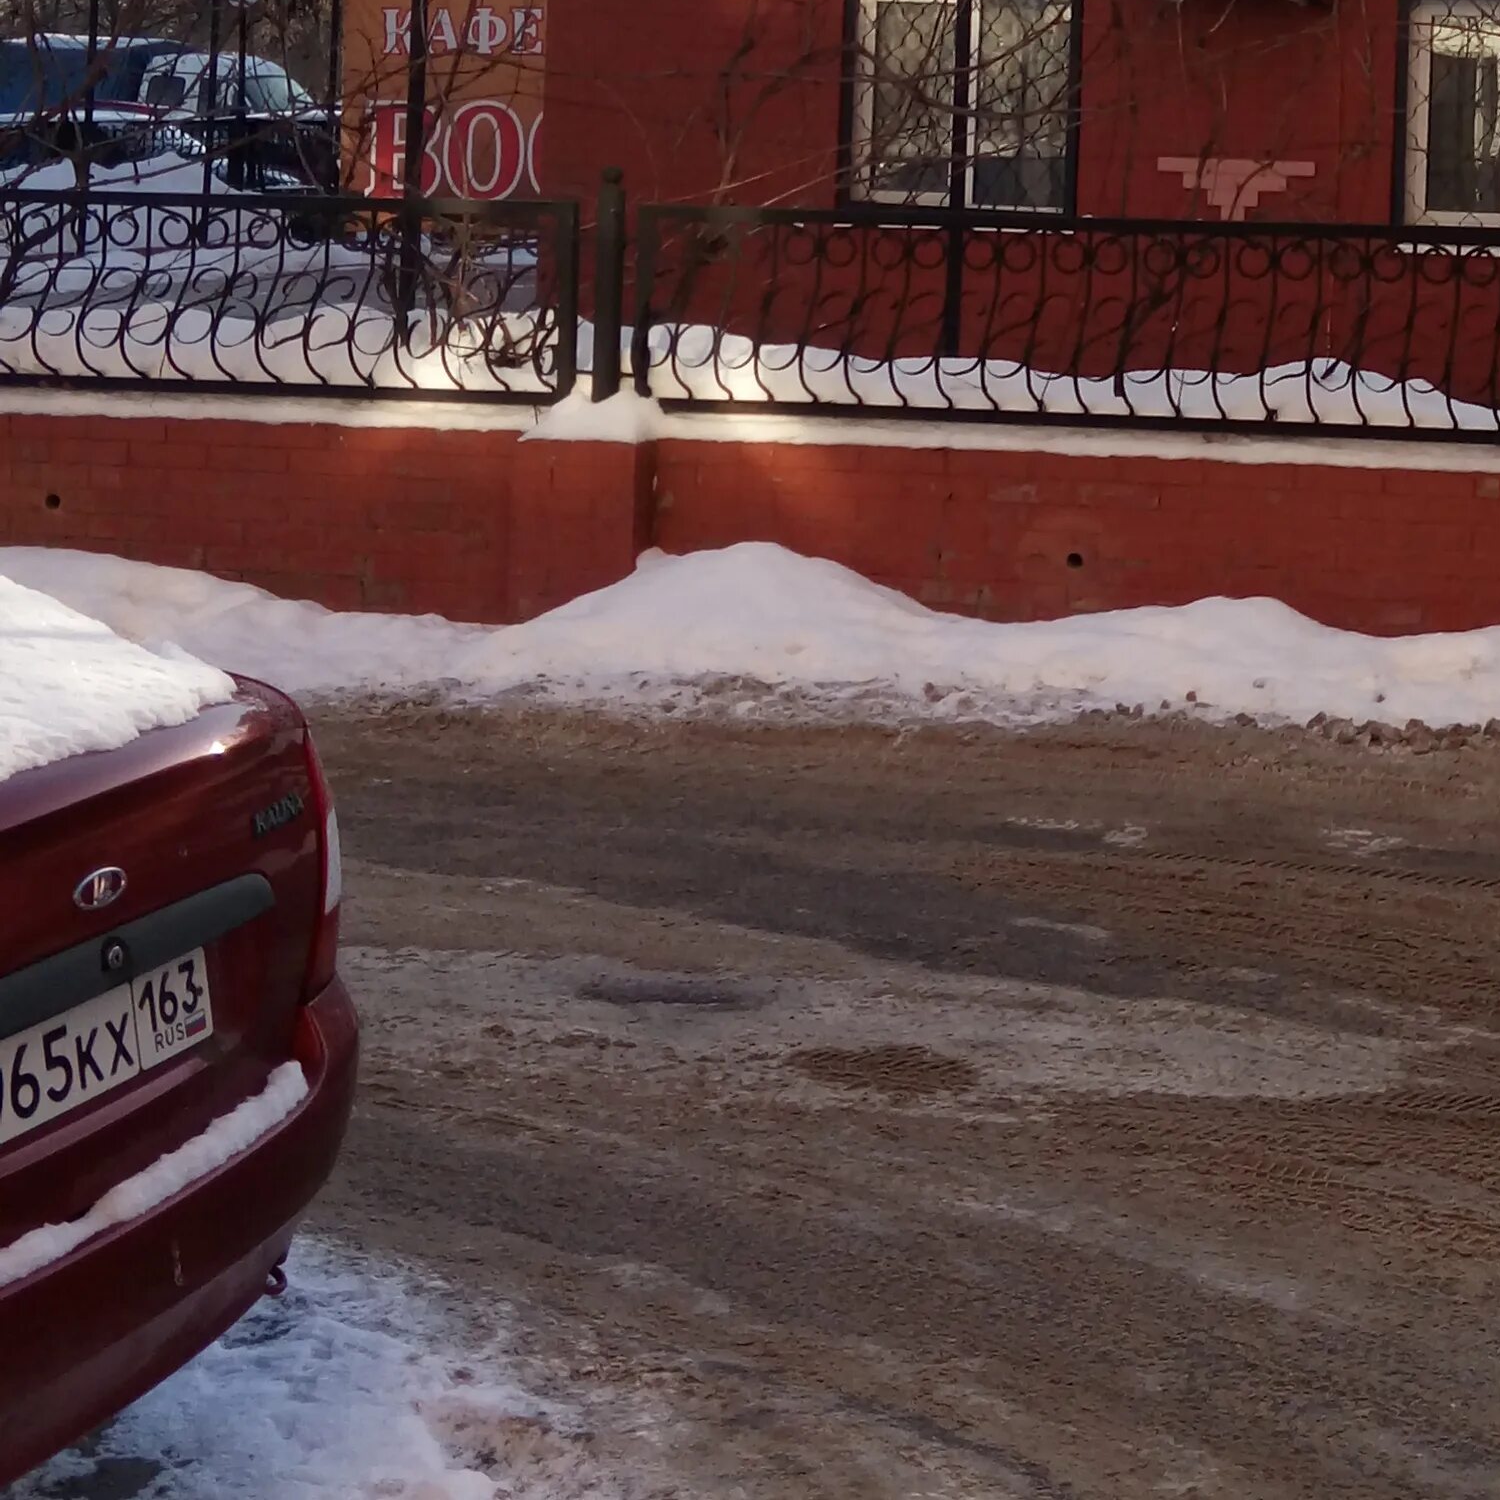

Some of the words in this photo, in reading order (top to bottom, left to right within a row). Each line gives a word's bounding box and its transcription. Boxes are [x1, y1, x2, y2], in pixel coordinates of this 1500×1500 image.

[382, 6, 544, 55] КАФЕ
[364, 100, 544, 201] ВО
[138, 959, 201, 1032] 163
[154, 1023, 185, 1053] RUS
